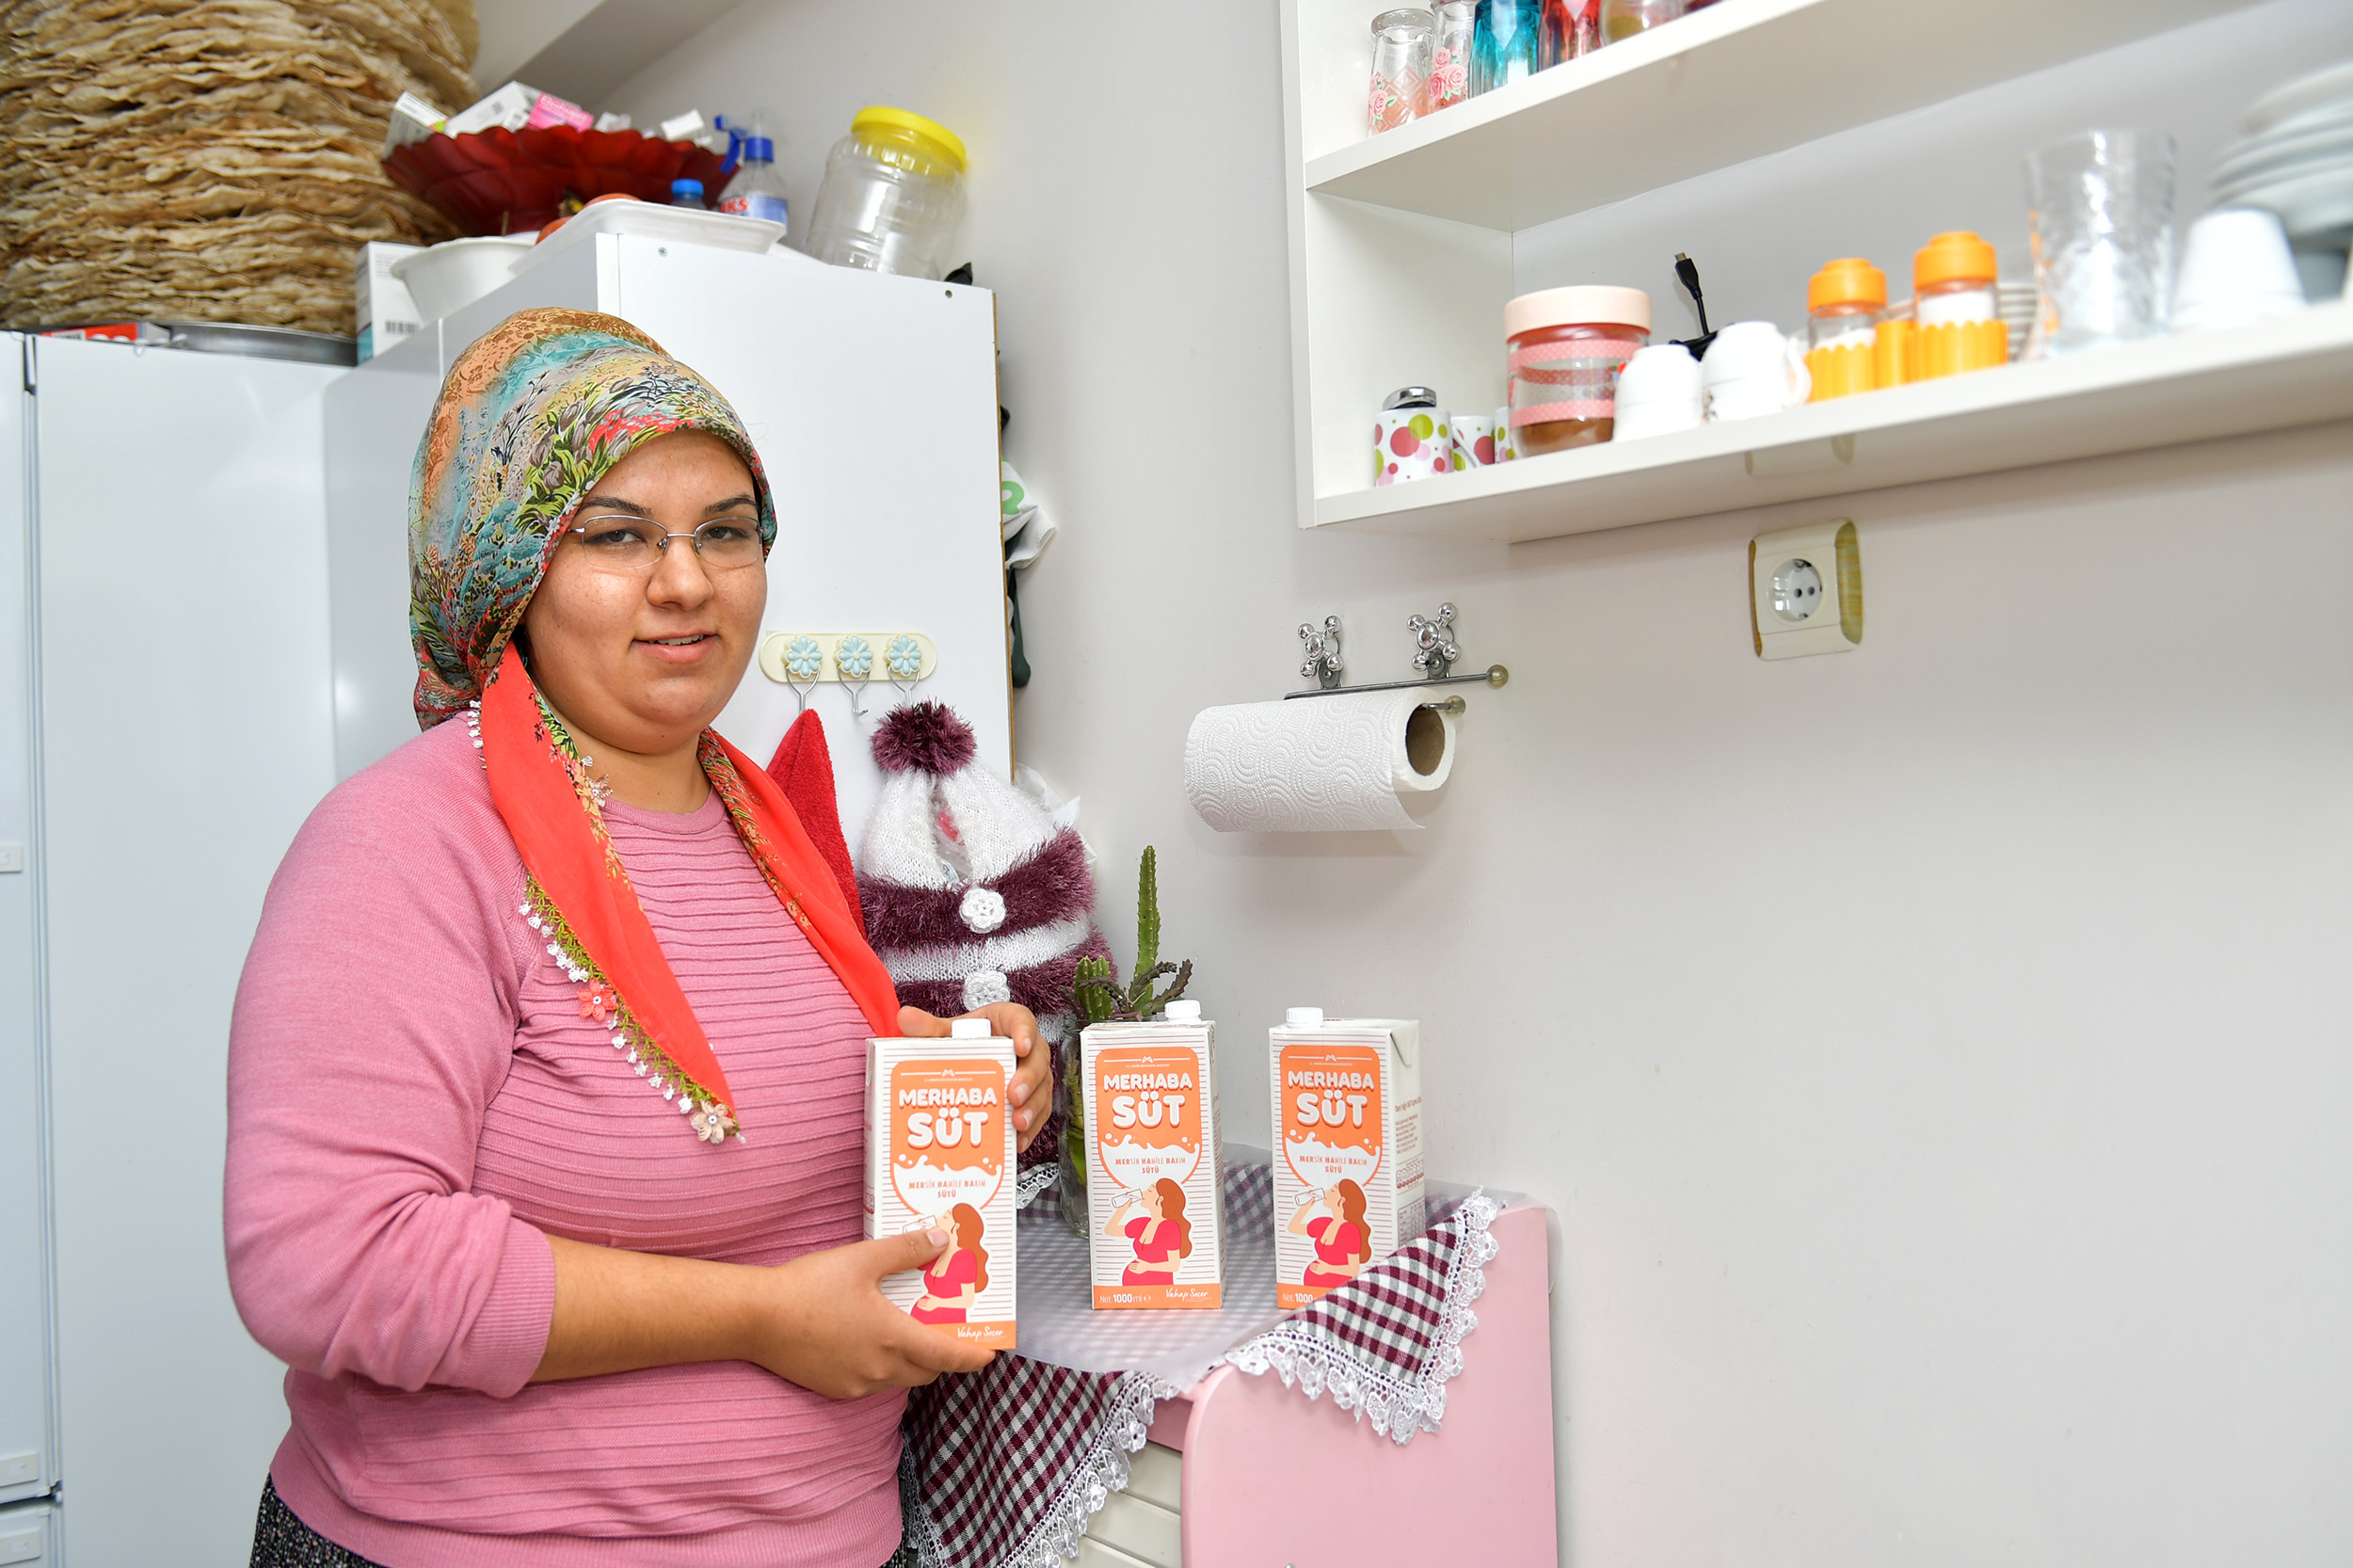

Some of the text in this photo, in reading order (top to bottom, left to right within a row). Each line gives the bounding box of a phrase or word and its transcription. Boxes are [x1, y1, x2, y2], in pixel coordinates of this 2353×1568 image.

[1103, 1072, 1193, 1093] MERHABA
[1287, 1070, 1374, 1092] MERHABA
[899, 1087, 998, 1109] MERHABA
[1112, 1091, 1186, 1129] SÜT
[1296, 1089, 1369, 1129] SÜT
[907, 1107, 989, 1150] SÜT
[937, 1189, 957, 1198] SÜTÜ
[1112, 1293, 1133, 1304] 1000
[1165, 1288, 1188, 1302] Vahap
[1294, 1292, 1314, 1304] 1000
[957, 1325, 982, 1342] Vahap
